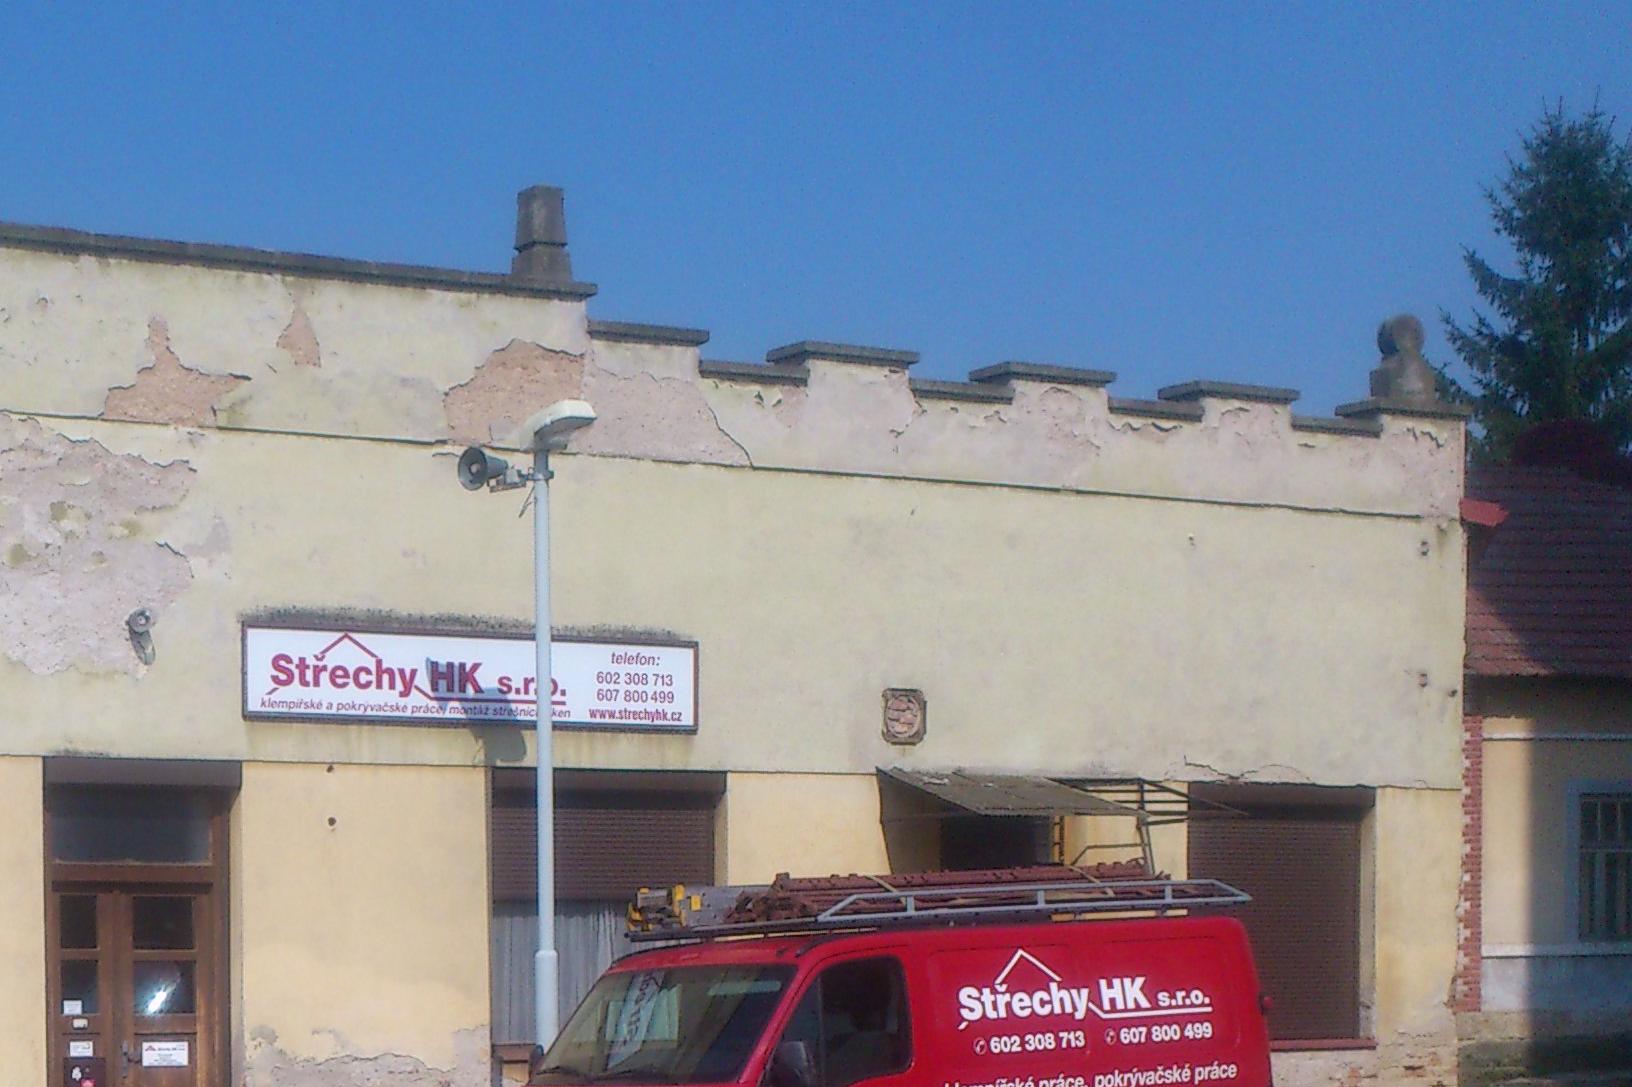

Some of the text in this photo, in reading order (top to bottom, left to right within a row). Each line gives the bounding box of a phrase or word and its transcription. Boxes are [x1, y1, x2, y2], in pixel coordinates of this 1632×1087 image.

[611, 652, 661, 666] telefon:
[270, 653, 418, 698] Střechy
[430, 661, 485, 694] HK
[596, 671, 673, 687] 602 308 713
[596, 688, 674, 704] 607 800 499
[325, 702, 333, 711] a
[551, 706, 571, 718] ken
[588, 708, 683, 723] www.strechyhk.cz
[958, 976, 1211, 1021] Střechy HK s.r.o.
[990, 1030, 1086, 1054] 602 308 713
[1120, 1021, 1213, 1045] 607 800 499
[1194, 1060, 1238, 1085] práce
